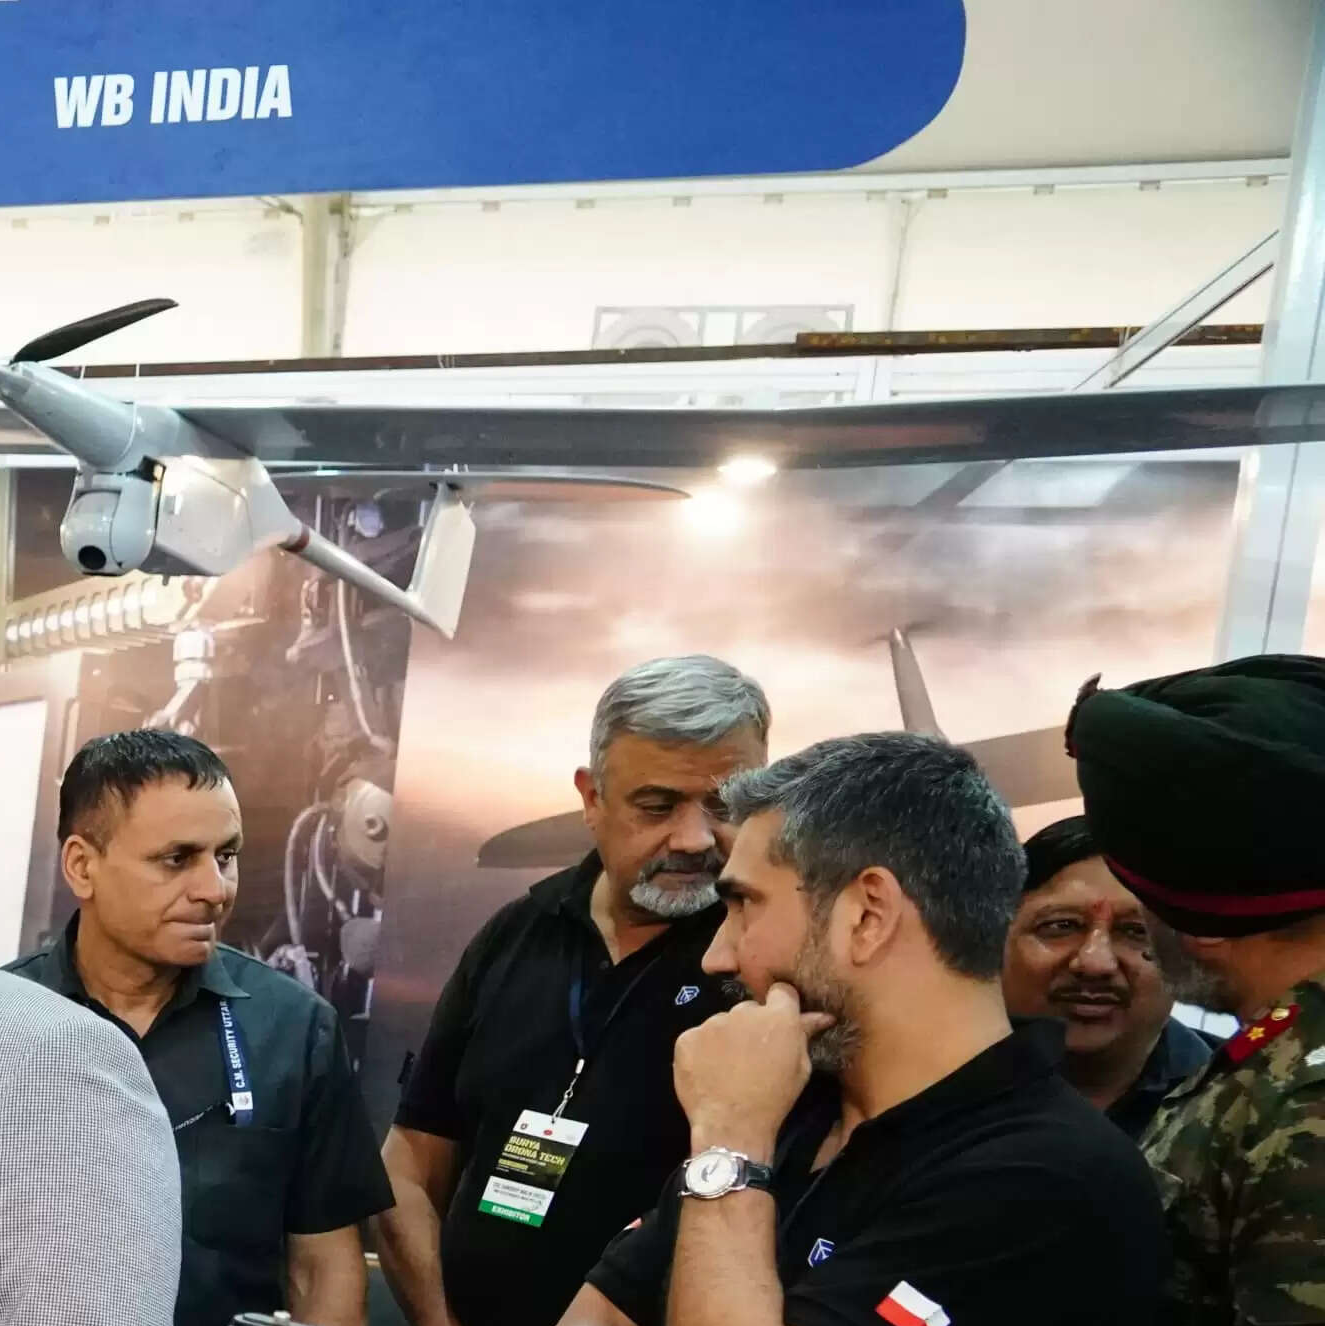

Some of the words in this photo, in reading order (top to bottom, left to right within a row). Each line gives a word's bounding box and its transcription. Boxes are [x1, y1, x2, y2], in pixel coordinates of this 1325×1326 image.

[54, 74, 135, 129] WB
[150, 64, 292, 124] INDIA
[224, 1028, 242, 1069] SECURITY
[233, 1070, 246, 1088] C.M.
[509, 1136, 541, 1151] SURYA
[504, 1144, 538, 1160] DRONA
[539, 1151, 566, 1166] TECH
